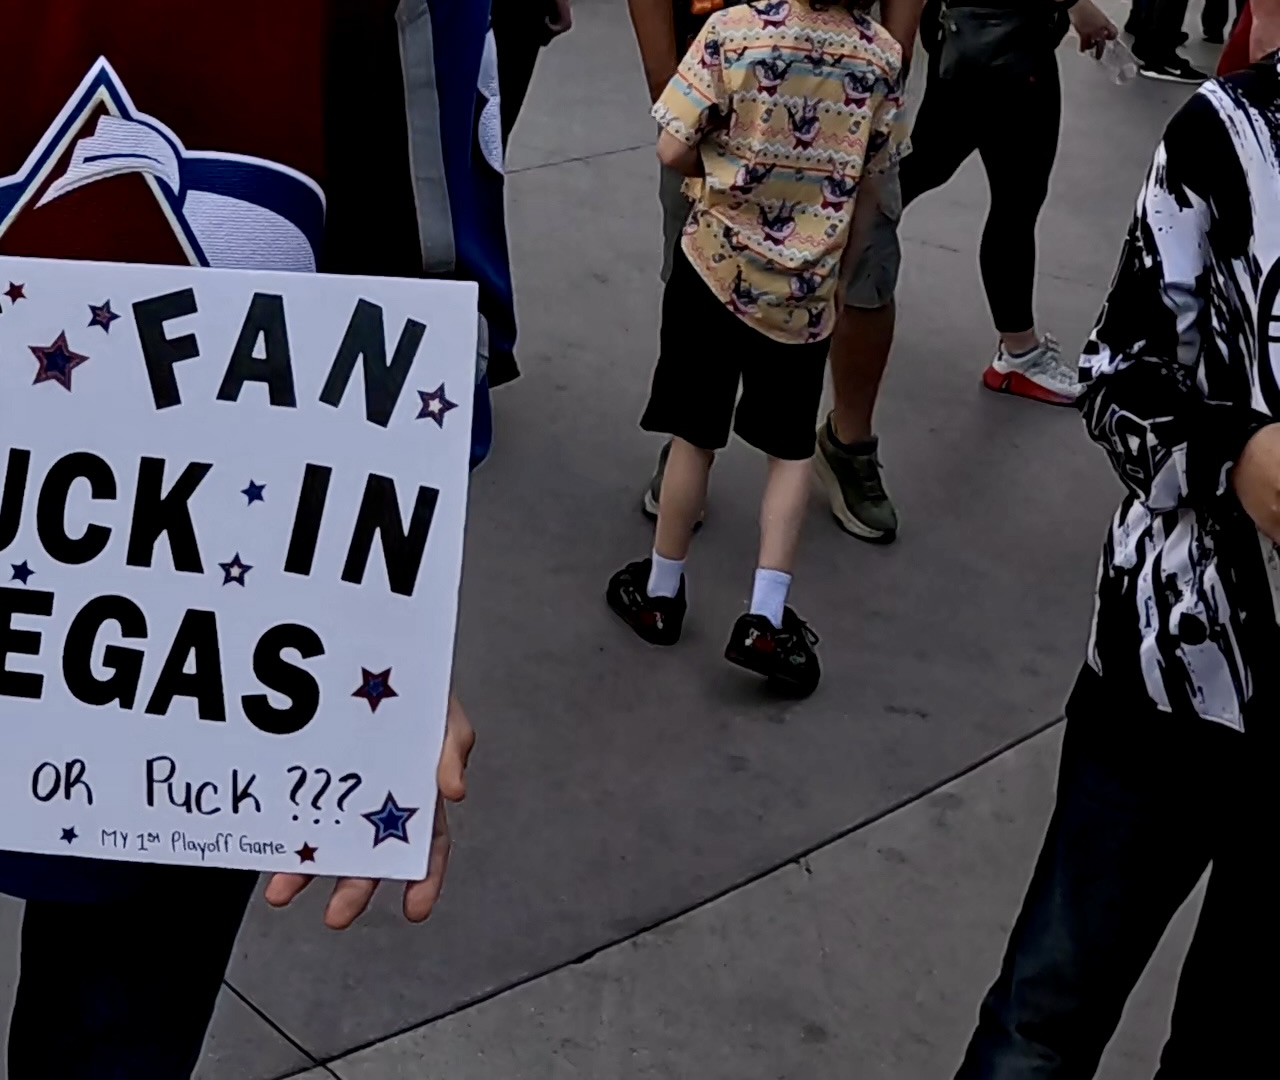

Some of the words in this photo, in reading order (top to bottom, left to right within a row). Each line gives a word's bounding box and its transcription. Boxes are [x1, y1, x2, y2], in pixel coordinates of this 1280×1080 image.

[132, 287, 427, 428] FAN
[283, 463, 440, 598] IN
[31, 760, 93, 807] OR
[145, 755, 263, 816] Puck
[285, 765, 364, 827] ???
[170, 830, 234, 862] Playoff
